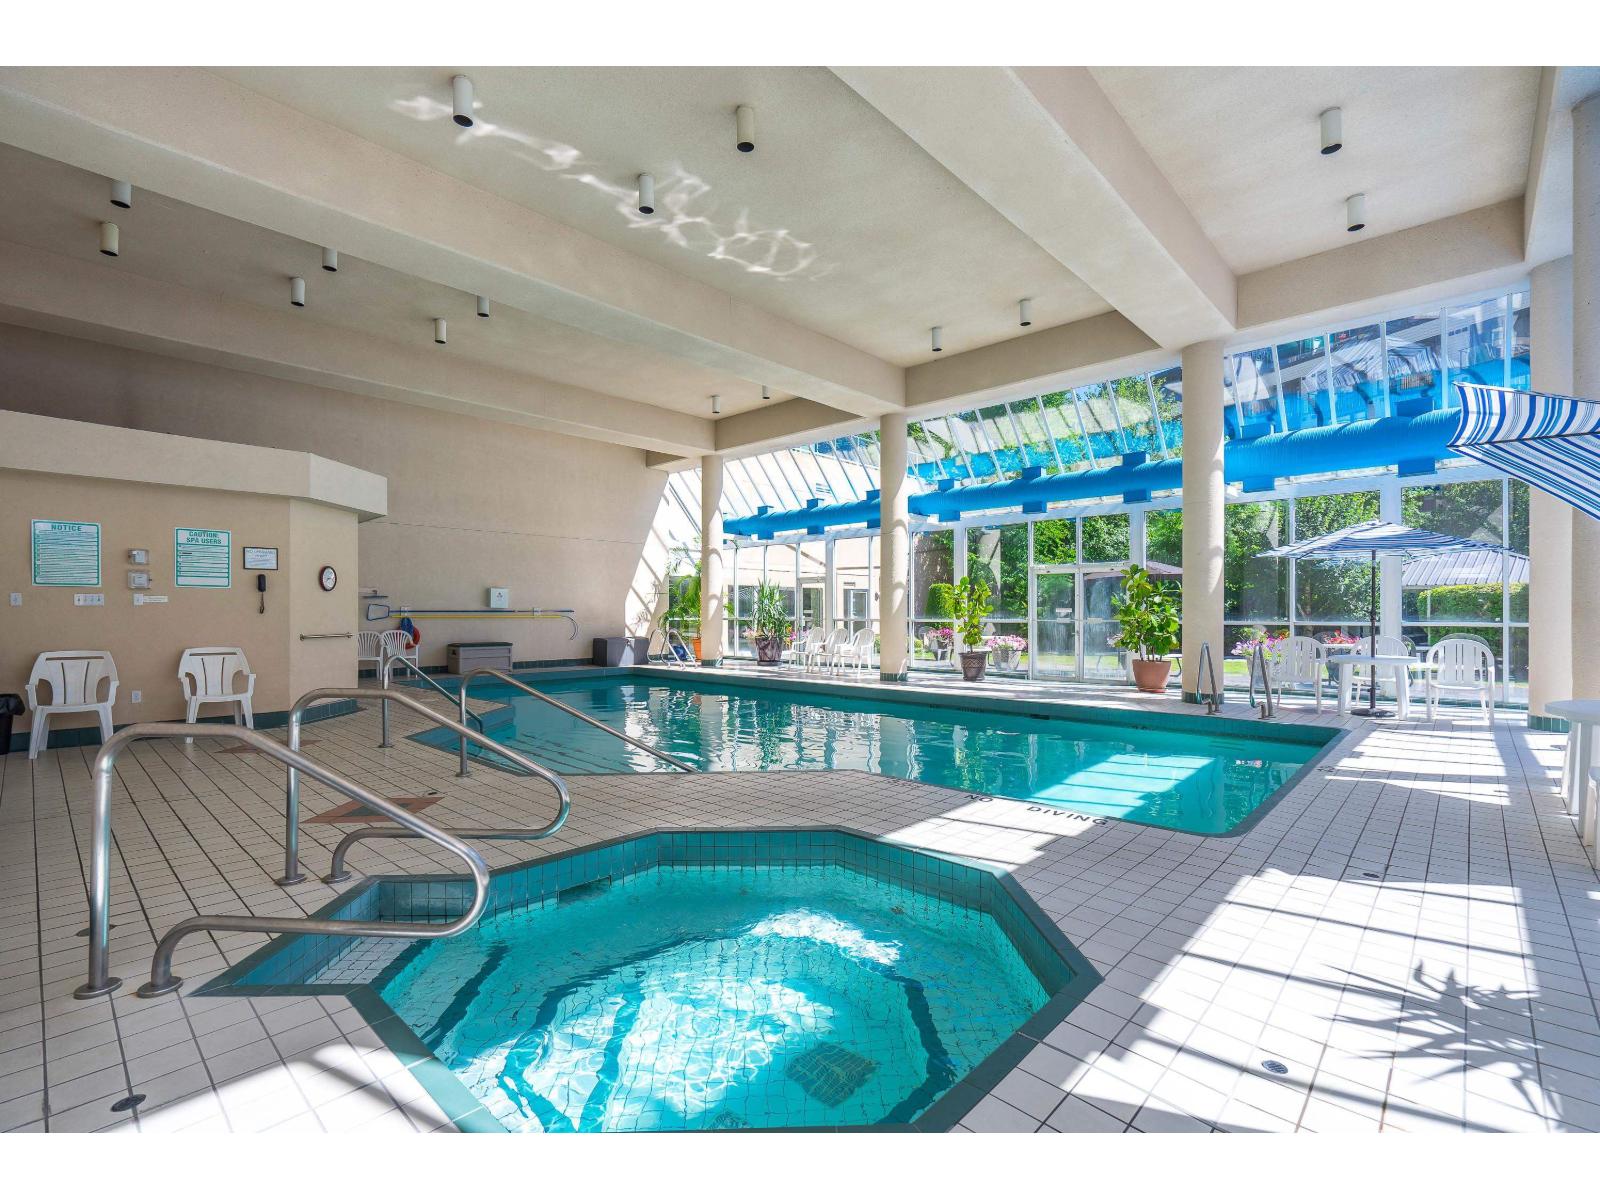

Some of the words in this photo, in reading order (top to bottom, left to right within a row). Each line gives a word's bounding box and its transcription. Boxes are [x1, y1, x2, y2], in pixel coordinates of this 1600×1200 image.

[51, 524, 82, 532] NOTICE
[964, 794, 994, 803] NO
[1026, 806, 1109, 826] DIVING
